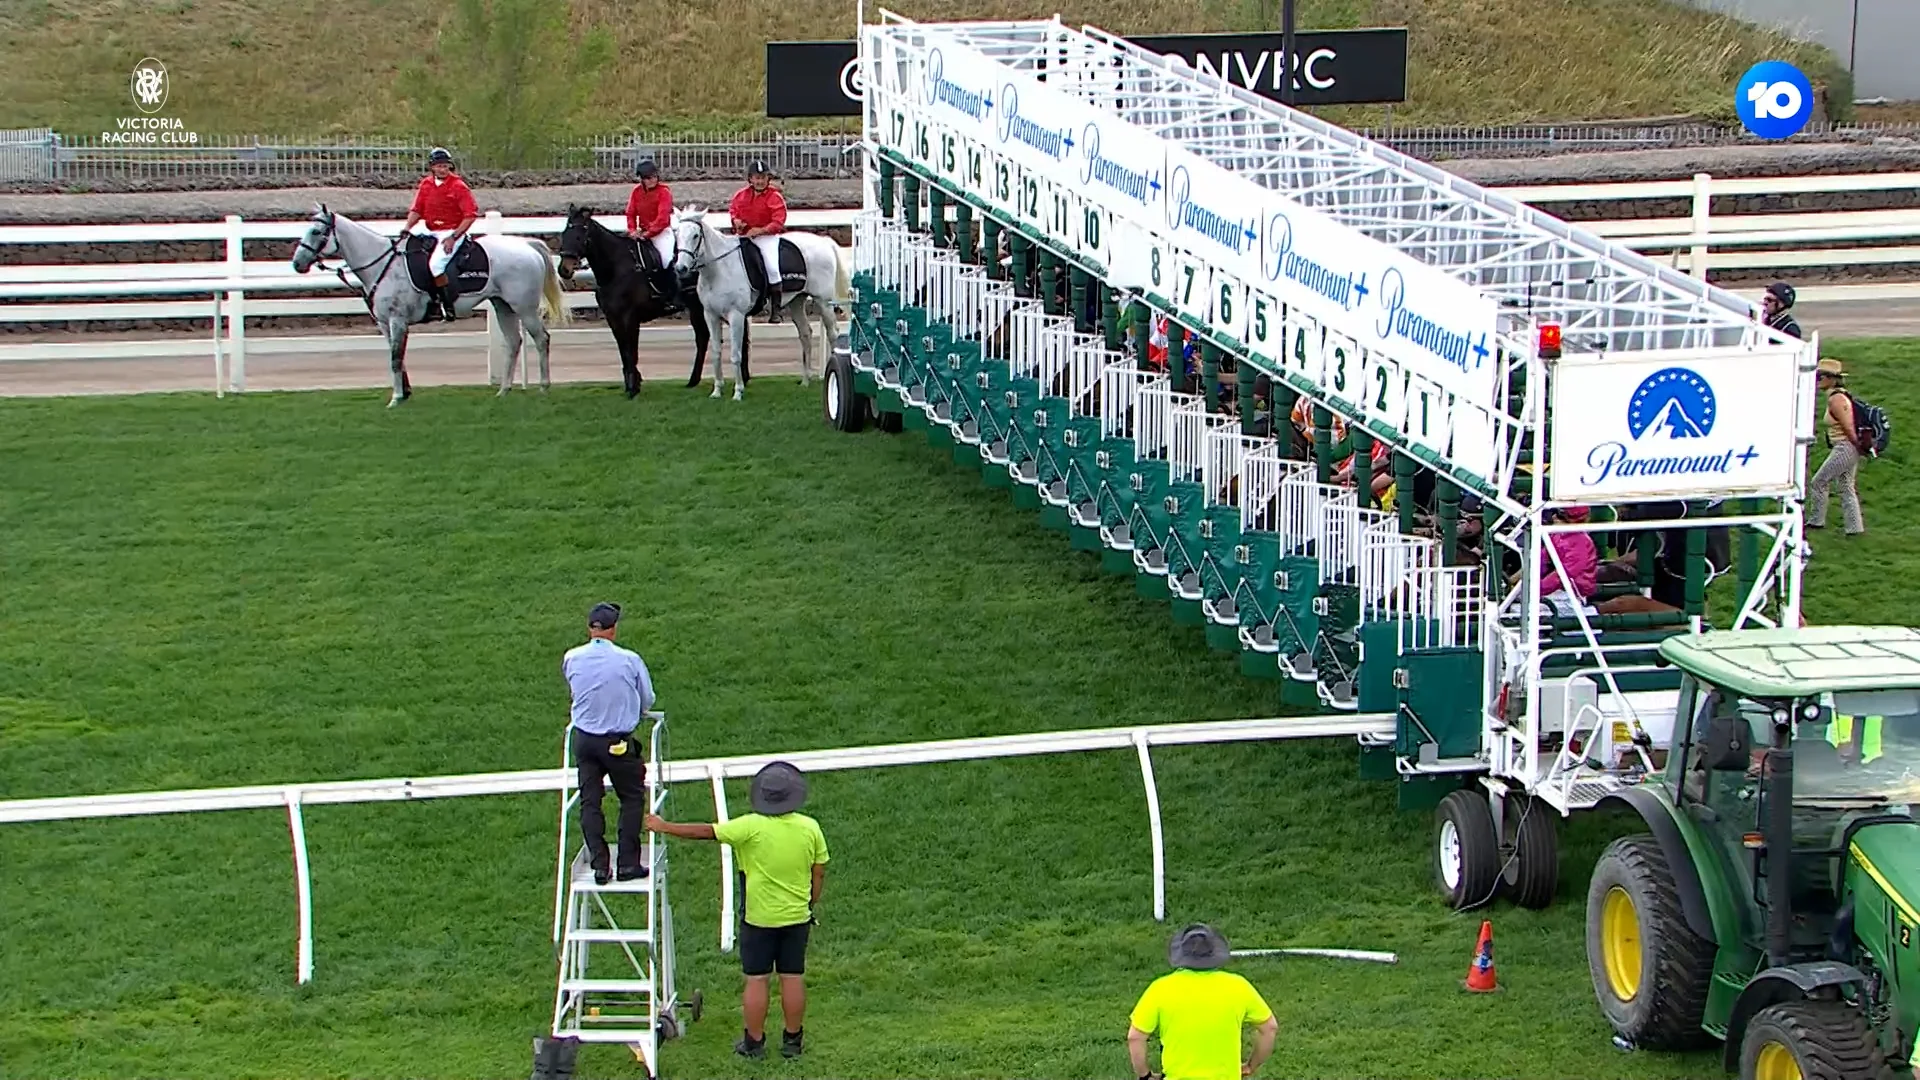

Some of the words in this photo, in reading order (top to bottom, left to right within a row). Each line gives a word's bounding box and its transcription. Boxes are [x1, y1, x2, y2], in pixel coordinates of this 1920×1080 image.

[927, 47, 993, 123] Paramount+
[891, 108, 904, 147] 17
[915, 120, 929, 161] 16
[999, 83, 1075, 162] Paramount+
[941, 133, 955, 173] 15
[968, 146, 981, 189] 14
[1080, 122, 1162, 207] Paramount+
[995, 161, 1009, 202] 13
[1023, 176, 1037, 218] 12
[1055, 193, 1067, 236] 11
[1084, 205, 1099, 250] 10
[1169, 165, 1257, 255] Paramount+
[1151, 247, 1161, 287] 8
[1265, 213, 1369, 311] Paramount+
[1184, 266, 1196, 306] 7
[1221, 283, 1232, 325] 6
[1255, 299, 1266, 342] 5
[1376, 267, 1490, 373] Paramount+
[1294, 326, 1305, 369] 4
[1334, 347, 1345, 392] 3
[1376, 365, 1387, 412] 2
[1420, 391, 1429, 437] 1
[1580, 441, 1759, 486] Paramount+
